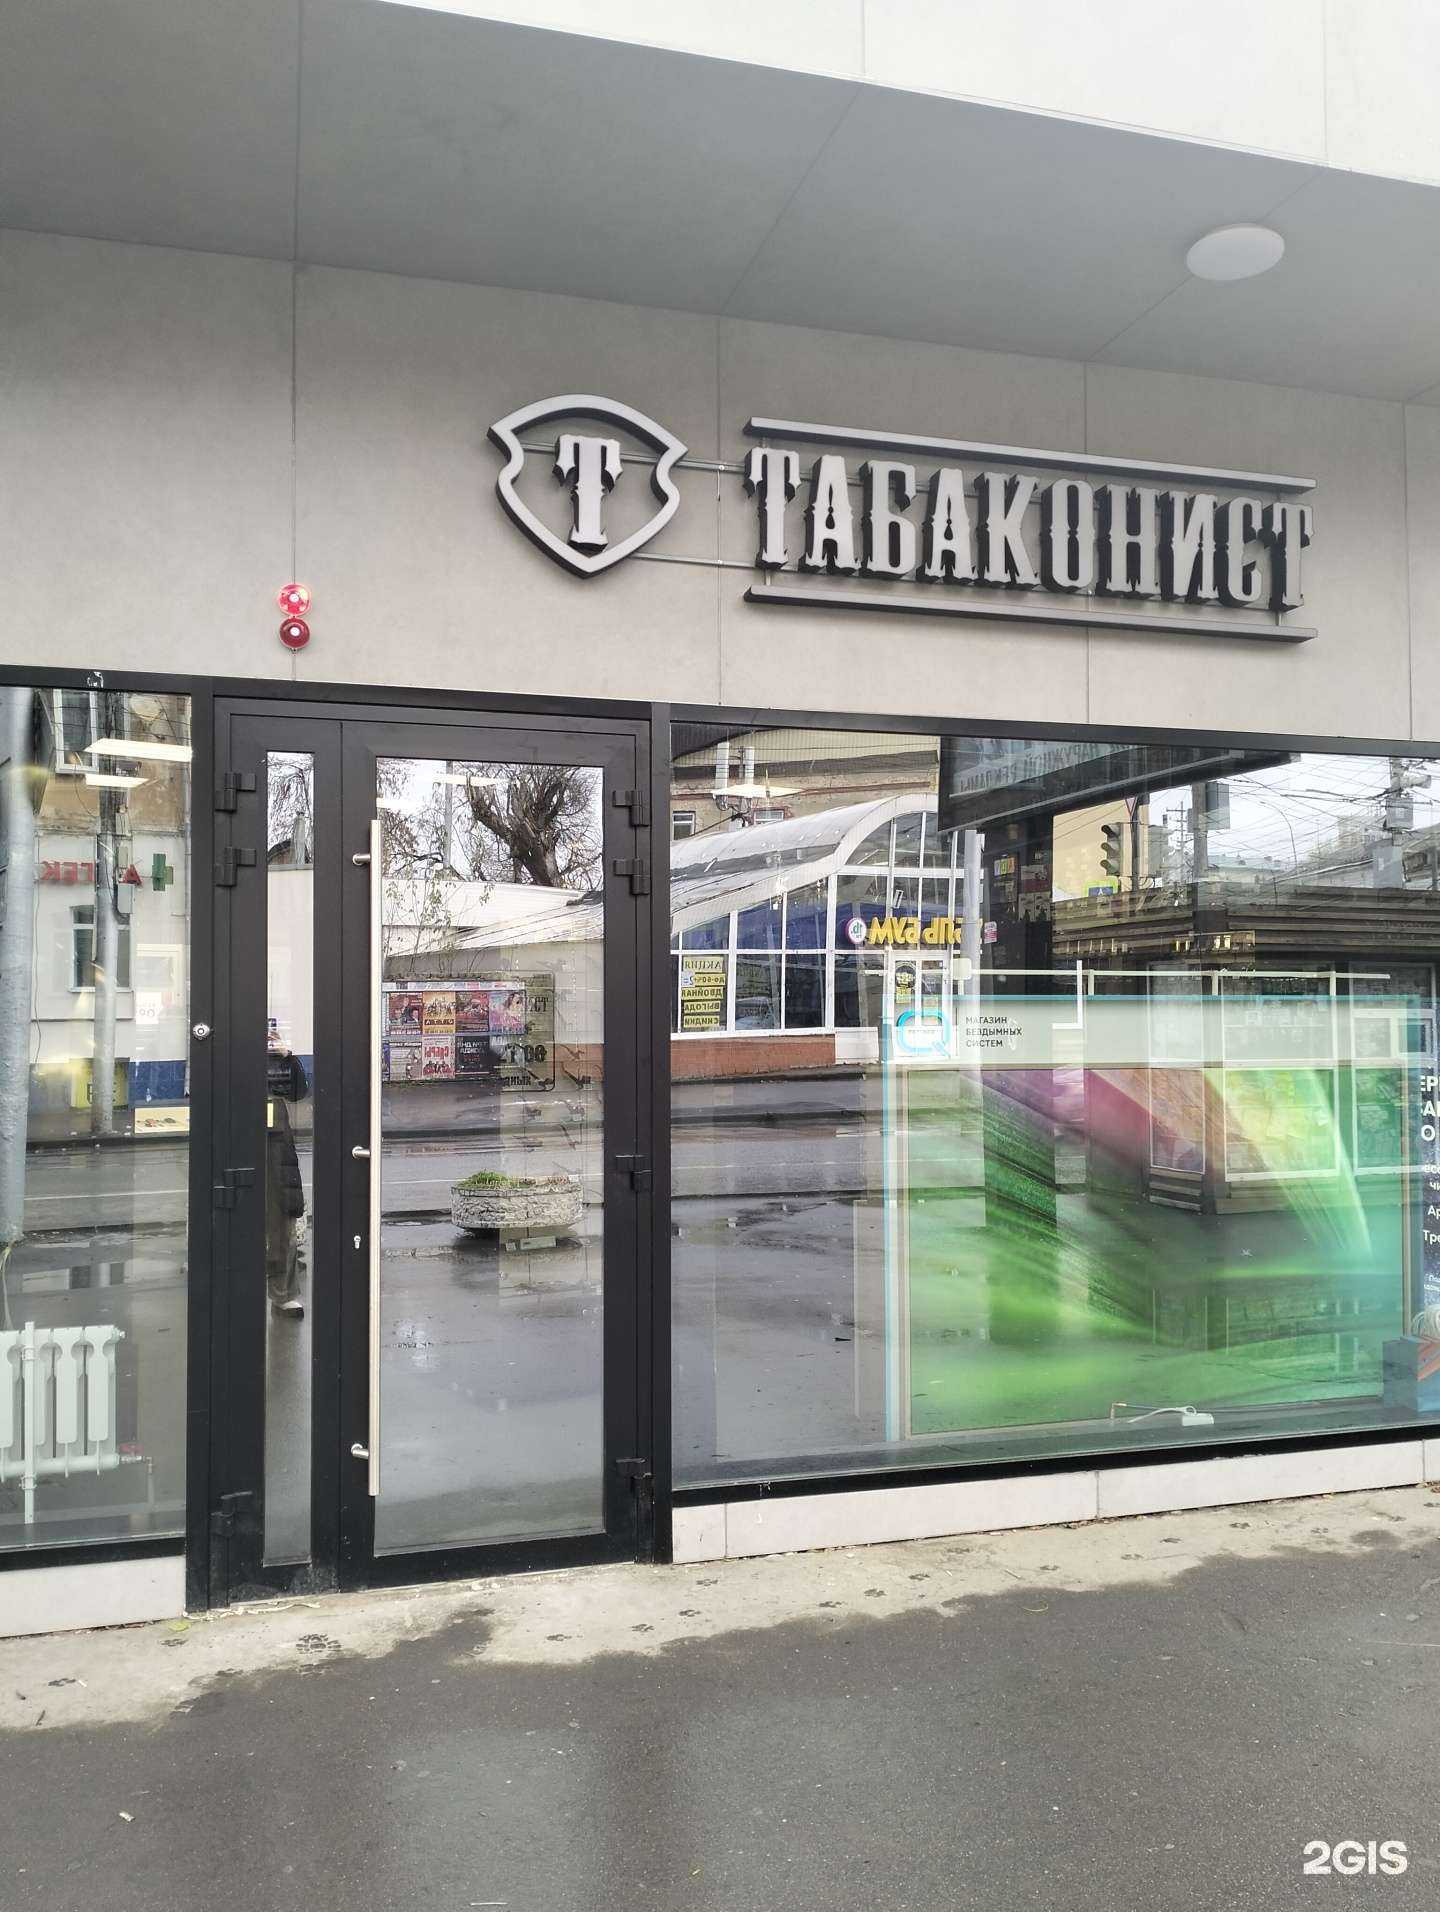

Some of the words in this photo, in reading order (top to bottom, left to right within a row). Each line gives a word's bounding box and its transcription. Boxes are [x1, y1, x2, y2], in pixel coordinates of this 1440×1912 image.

[745, 446, 1314, 609] ТАБАКОНИСТ
[966, 1016, 1008, 1024] МАГАЗИН
[966, 1027, 1023, 1037] БЕЗДЫМНЫХ
[966, 1039, 1003, 1048] СИСТЕМ
